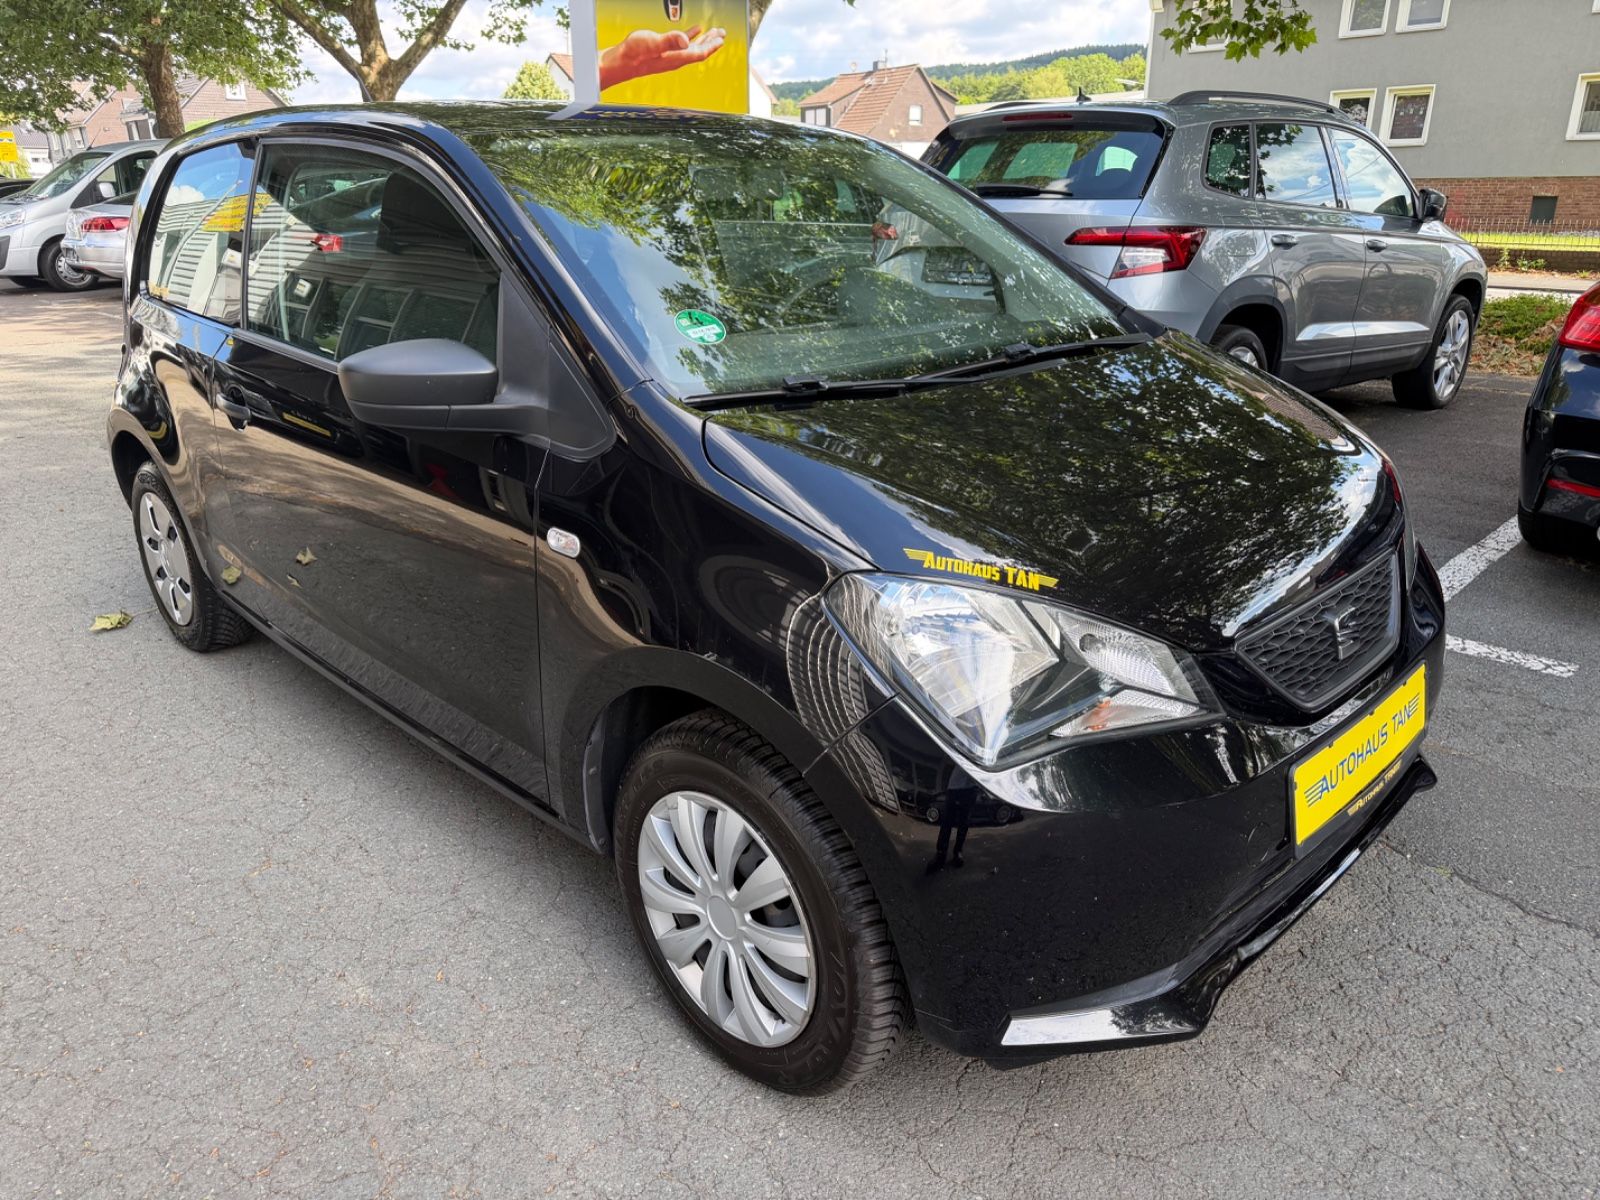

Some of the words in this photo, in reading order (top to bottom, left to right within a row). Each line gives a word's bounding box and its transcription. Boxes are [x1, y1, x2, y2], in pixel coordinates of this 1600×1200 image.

[922, 551, 1001, 582] AUTOHAUS
[1003, 565, 1041, 591] TAN
[1319, 721, 1389, 800] AUTOHAUS
[1391, 704, 1412, 734] TAN
